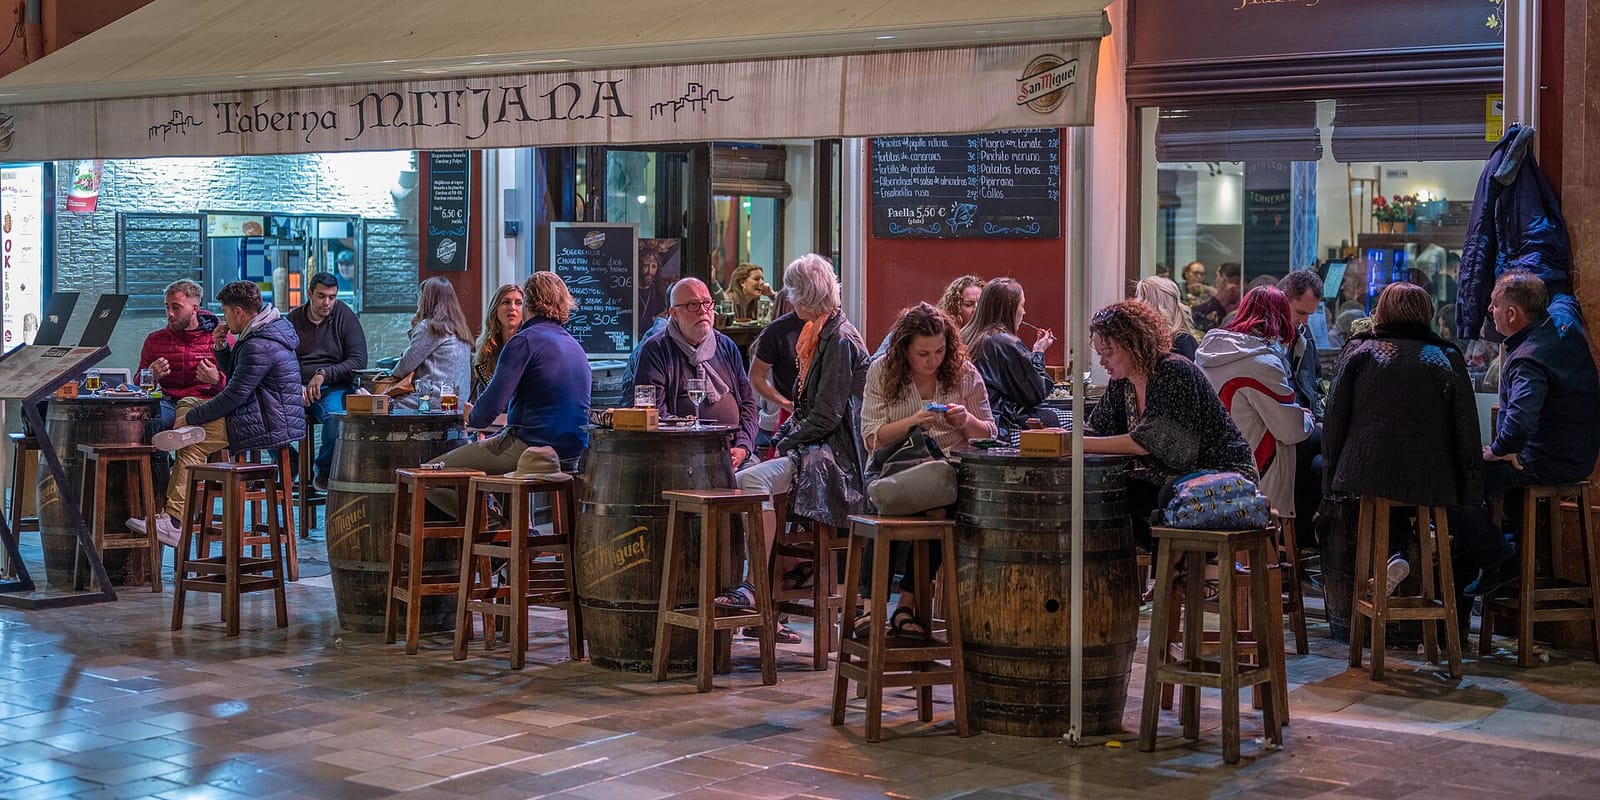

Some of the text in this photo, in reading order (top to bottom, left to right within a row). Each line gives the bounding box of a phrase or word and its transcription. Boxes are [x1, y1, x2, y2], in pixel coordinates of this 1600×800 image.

[213, 78, 633, 143] Taberna MITJANA
[980, 137, 1005, 152] Magro
[1017, 137, 1042, 149] tomate
[910, 152, 942, 161] camarones
[980, 150, 1010, 161] Pinchito
[1011, 153, 1040, 161] moruno
[910, 164, 936, 177] patatas
[980, 163, 1011, 175] Patatas
[1014, 163, 1041, 175] bravas
[980, 175, 1014, 189] Pipirrana
[914, 189, 930, 197] rusa
[981, 187, 1004, 199] Callos
[1250, 191, 1286, 204] TERNERA
[887, 207, 946, 219] Paella 5,50 €
[610, 275, 632, 288] 30€
[591, 313, 619, 326] 30€
[573, 324, 592, 334] people
